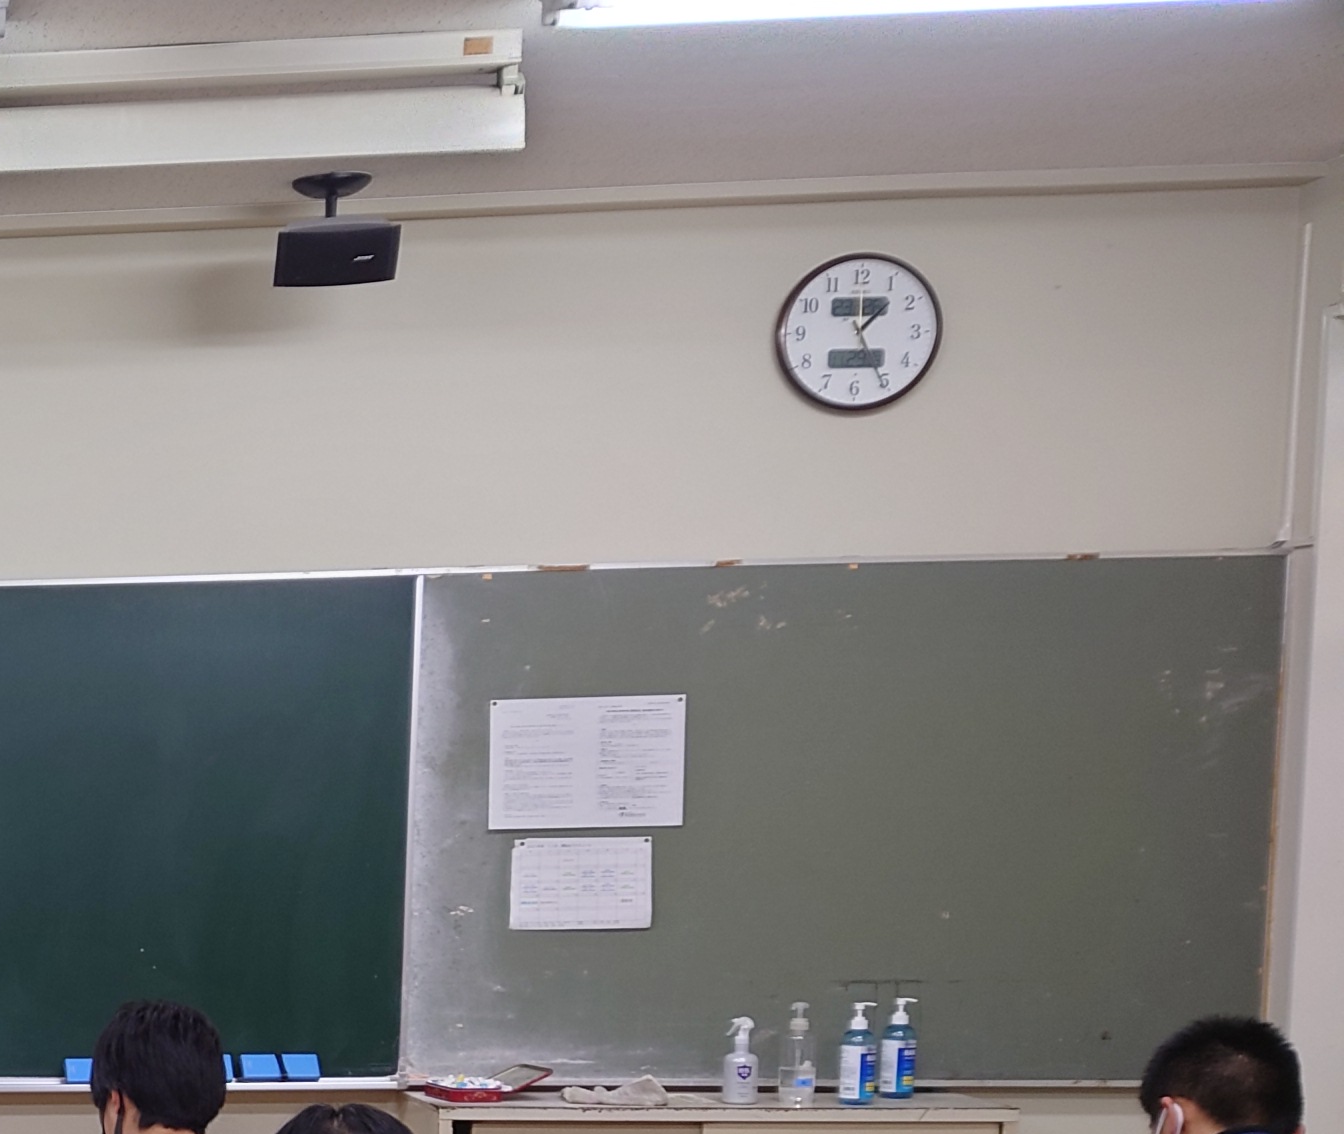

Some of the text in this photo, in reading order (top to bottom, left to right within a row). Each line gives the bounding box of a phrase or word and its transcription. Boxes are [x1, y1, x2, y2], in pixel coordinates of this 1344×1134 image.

[825, 276, 839, 293] 11
[853, 268, 871, 285] 12
[886, 275, 894, 292] 1
[802, 297, 819, 314] 10
[904, 294, 915, 311] 2
[794, 326, 807, 341] 9
[910, 324, 922, 340] 3
[801, 353, 812, 369] 8
[900, 351, 912, 368] 4
[820, 373, 833, 390] 7
[849, 380, 860, 396] 6
